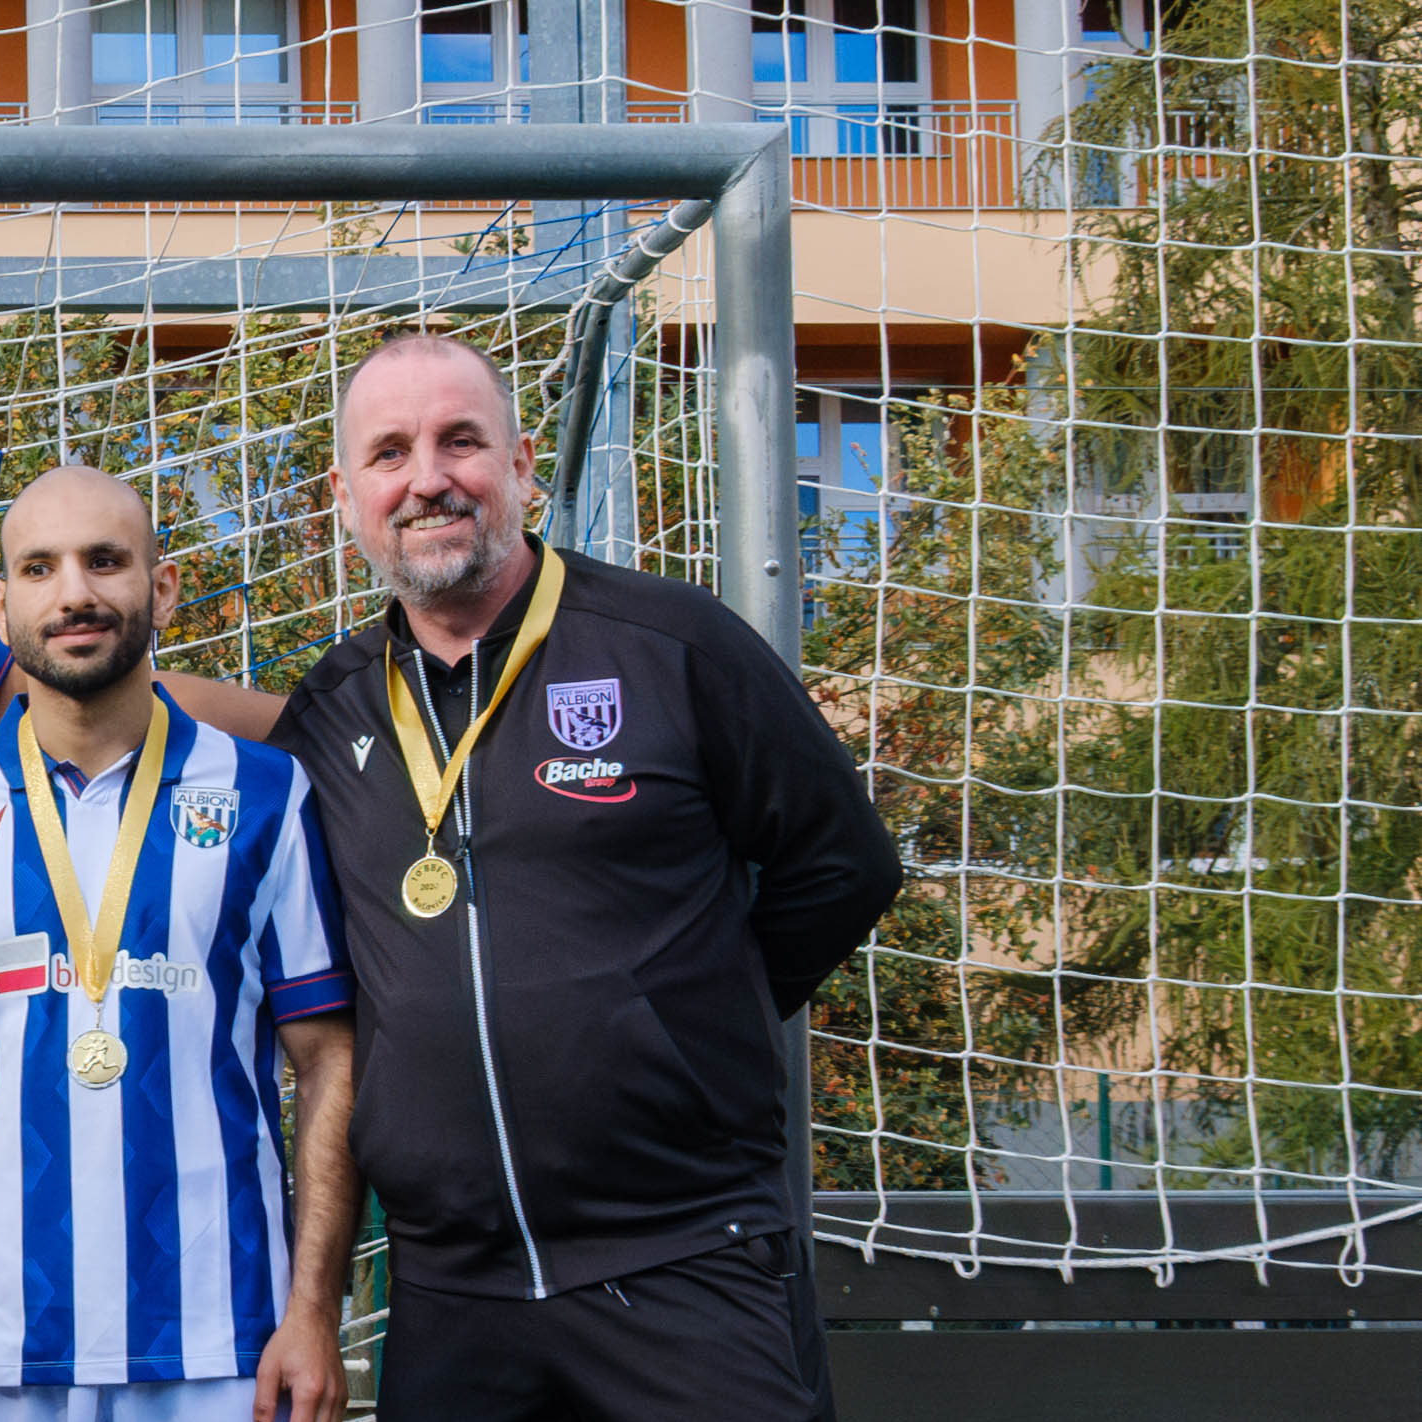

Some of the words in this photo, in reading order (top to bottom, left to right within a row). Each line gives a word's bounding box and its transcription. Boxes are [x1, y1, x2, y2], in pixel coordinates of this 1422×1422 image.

[556, 690, 612, 706] ALBION
[545, 758, 623, 784] Bache
[176, 793, 235, 808] ALBION
